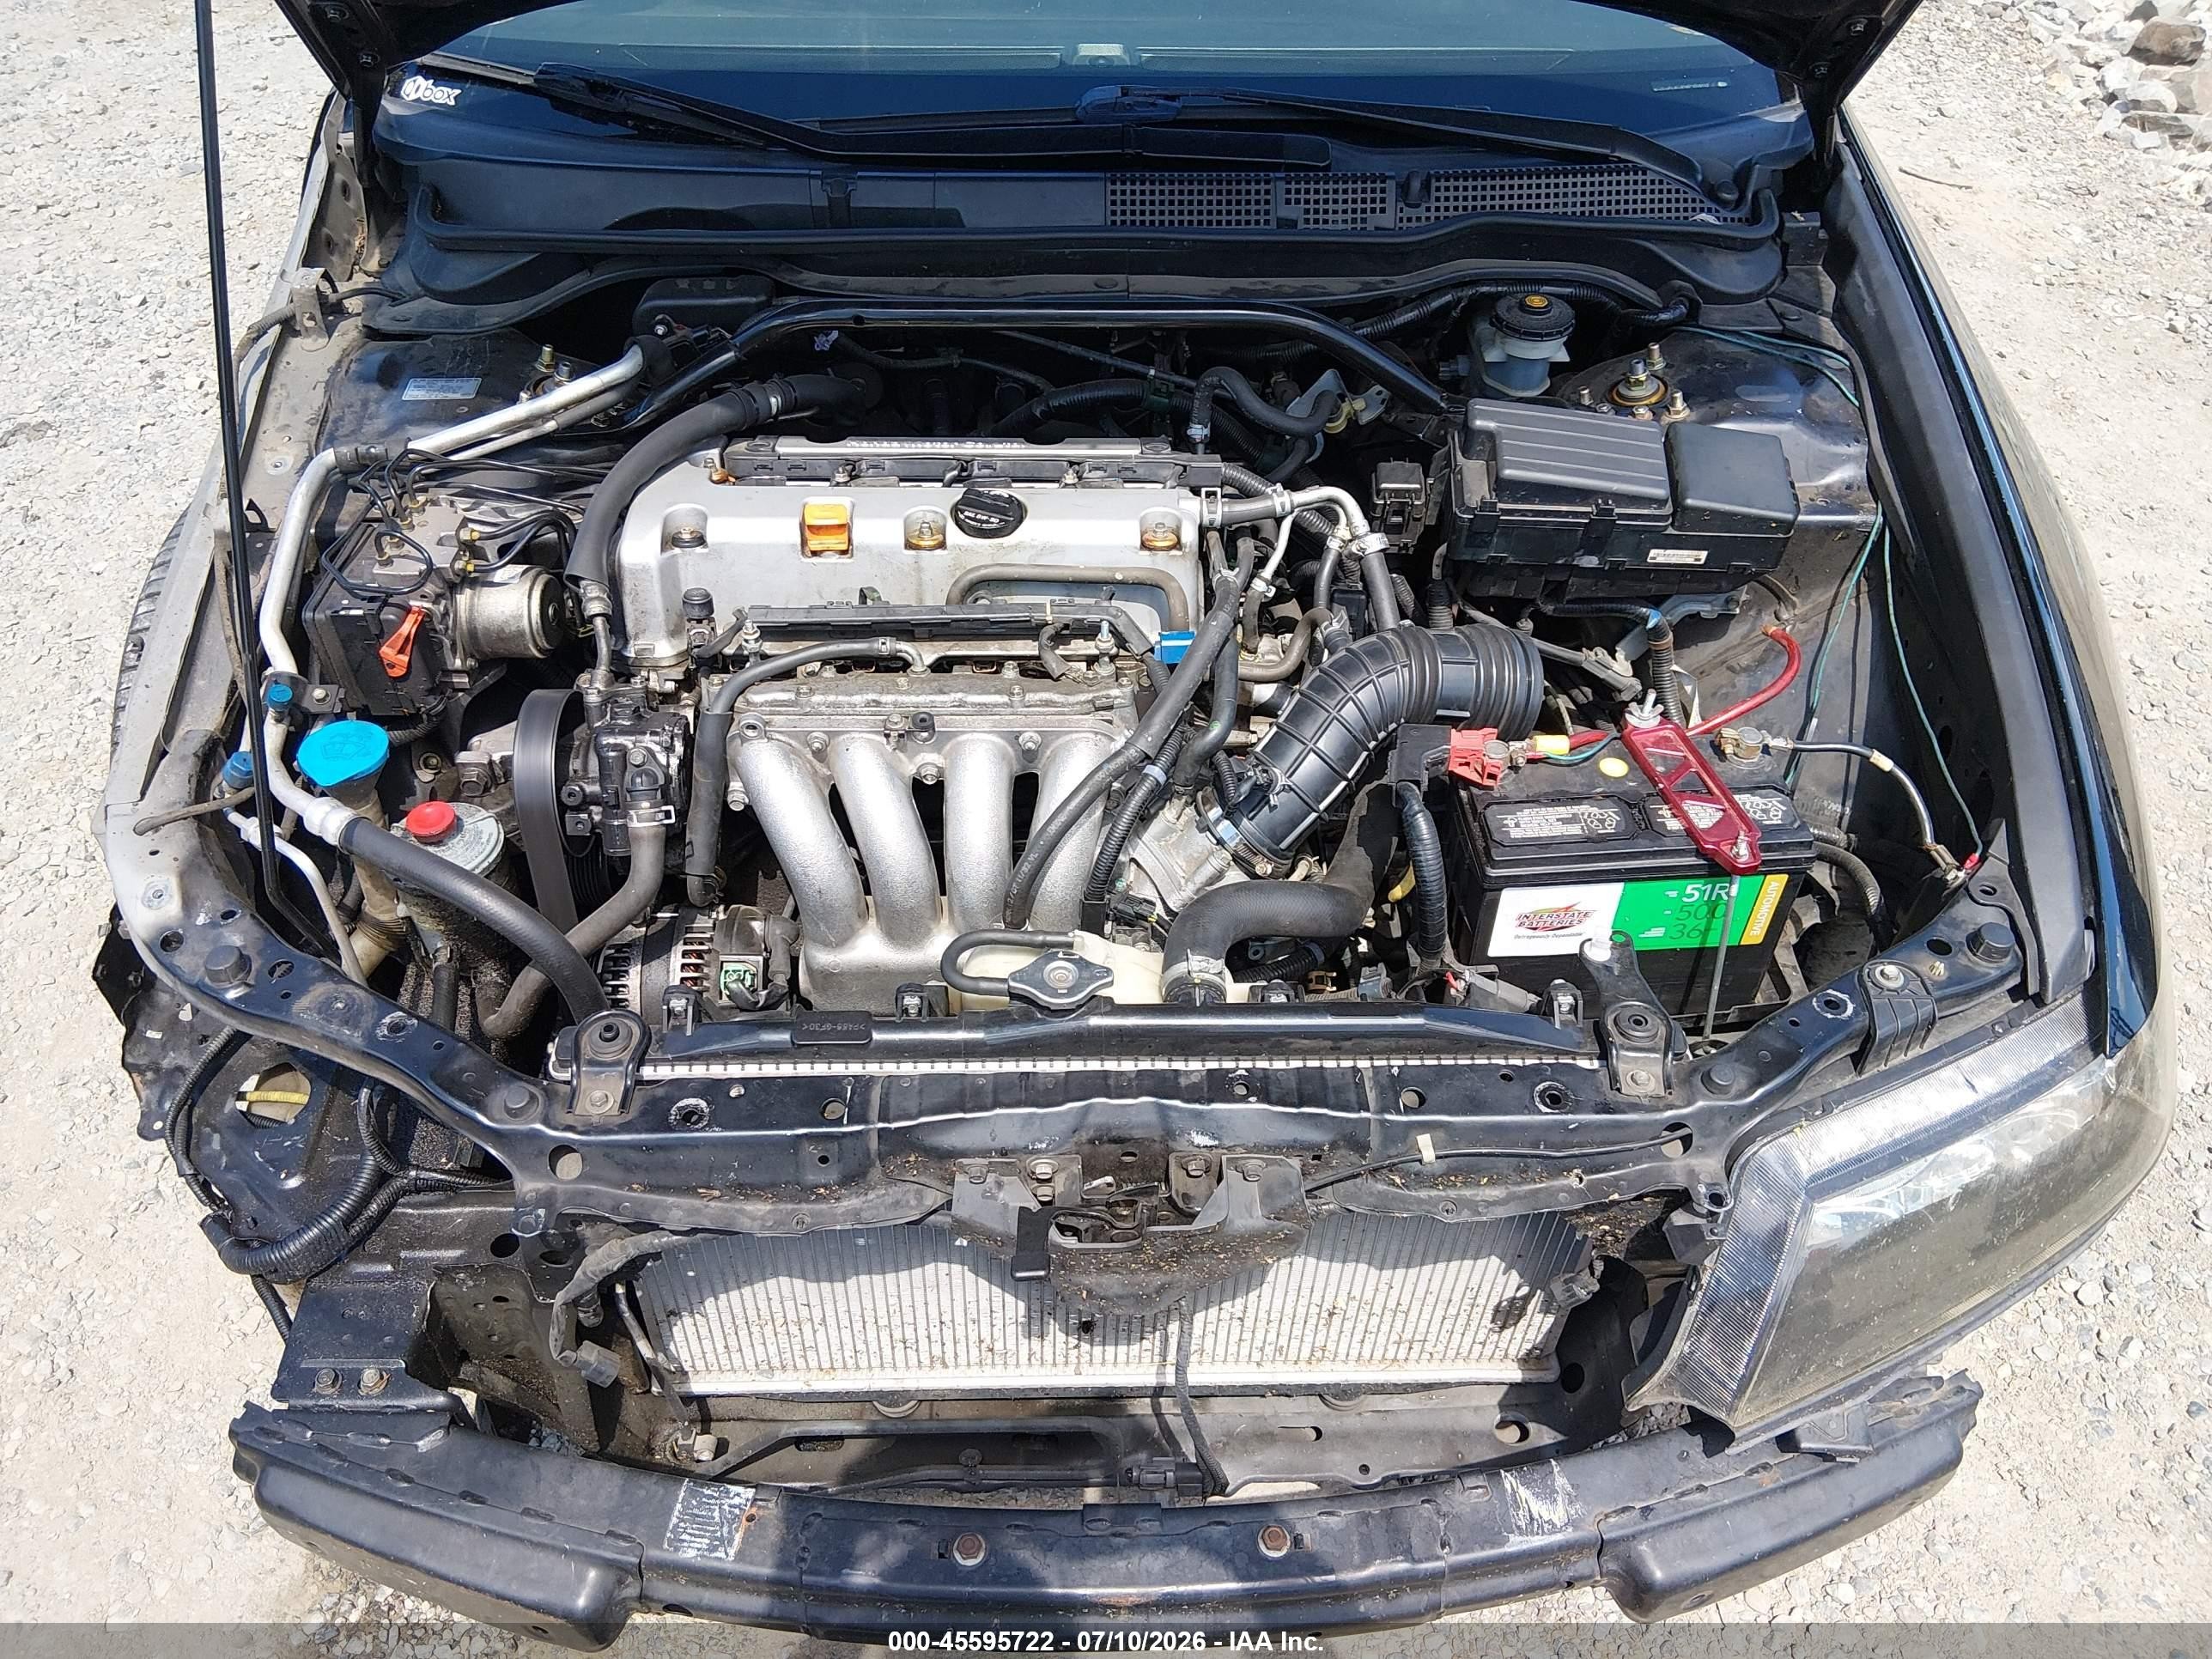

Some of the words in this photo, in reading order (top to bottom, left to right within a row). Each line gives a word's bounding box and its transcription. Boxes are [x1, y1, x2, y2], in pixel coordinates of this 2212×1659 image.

[1749, 881, 1780, 937] AUTOMOTIVE
[1517, 911, 1593, 921] INTERSTATE
[1517, 919, 1584, 928] BATTERIES
